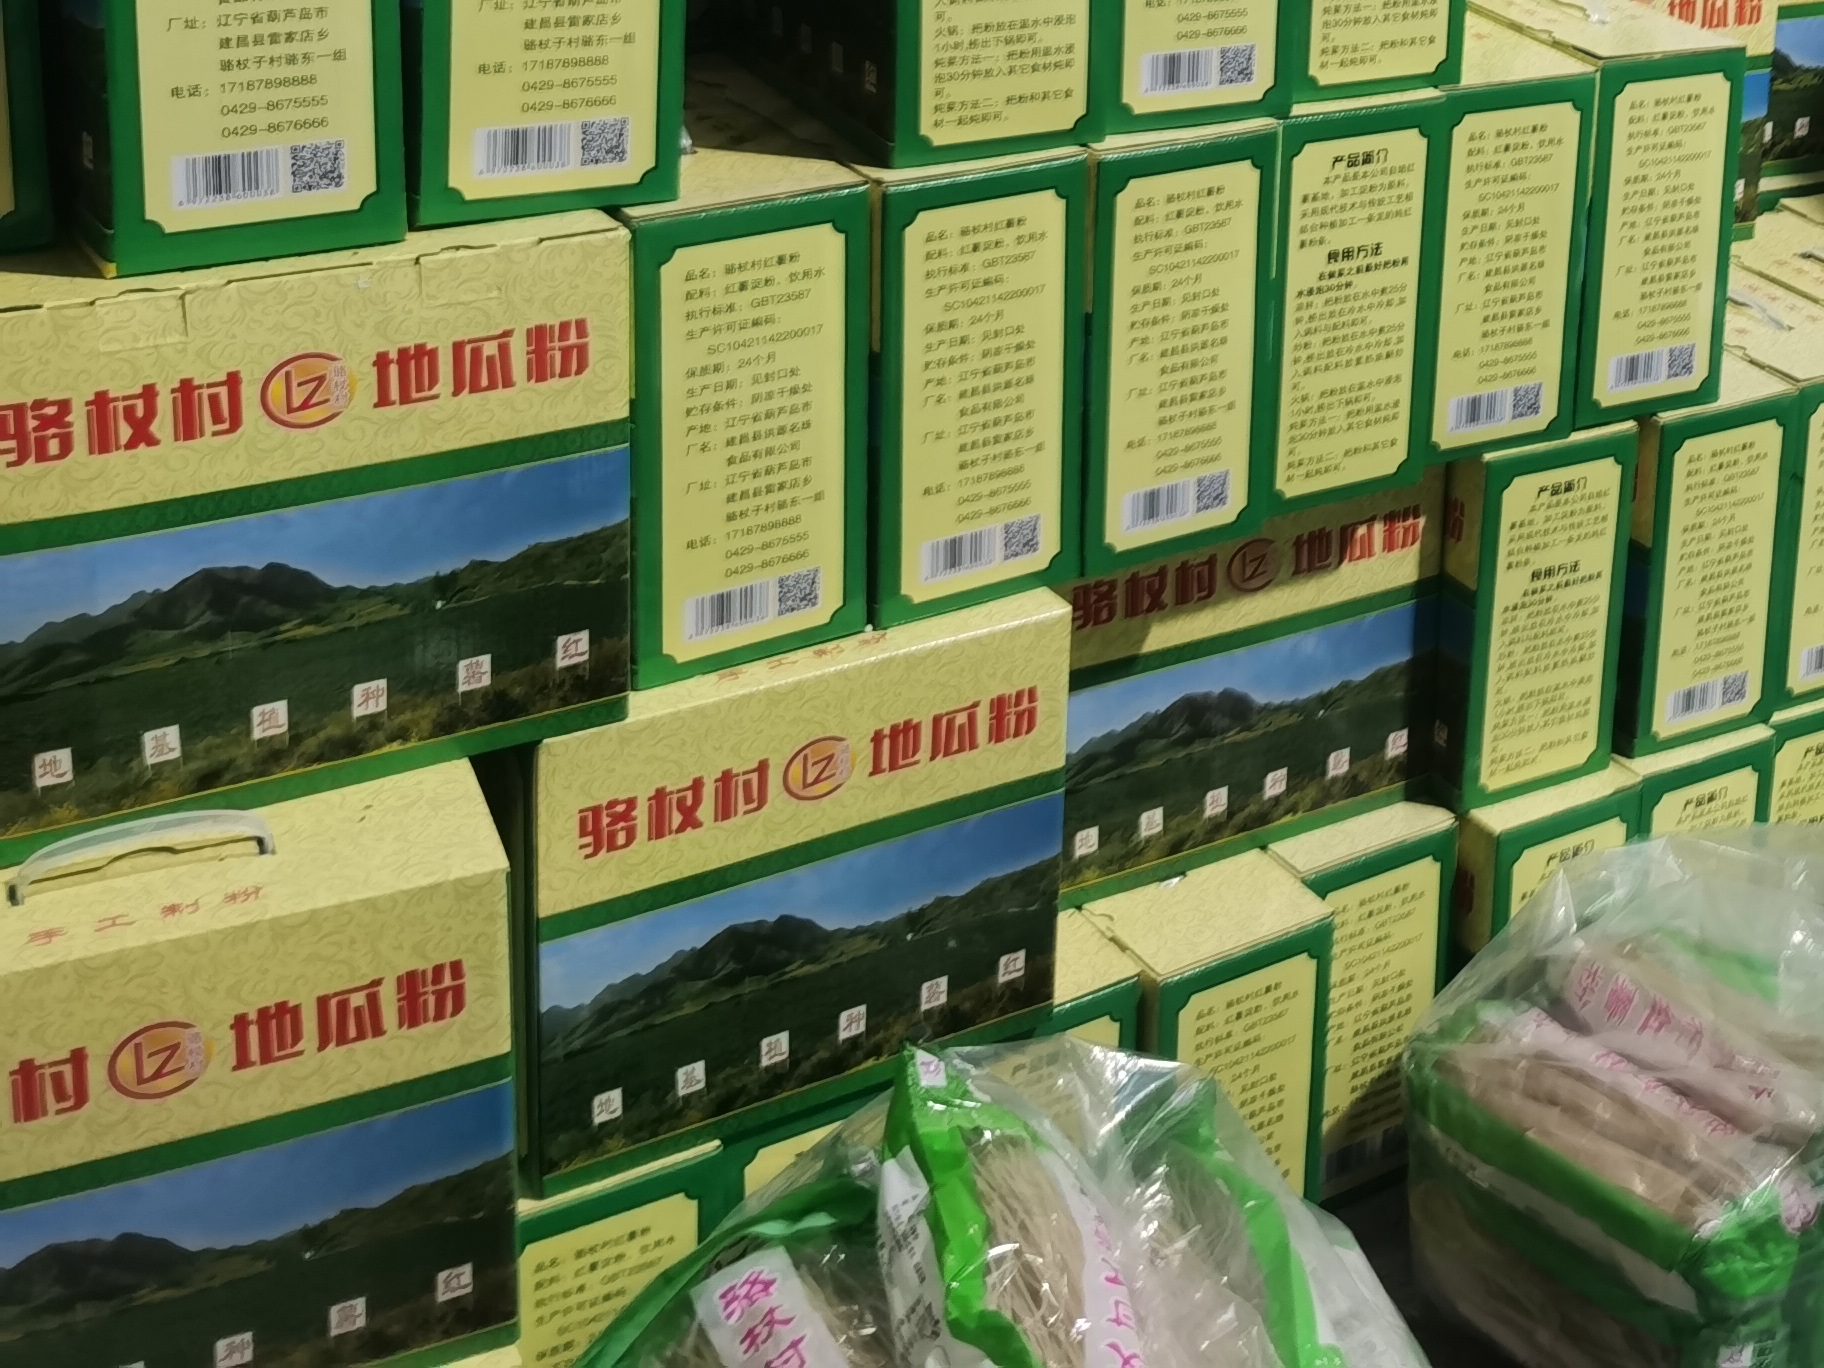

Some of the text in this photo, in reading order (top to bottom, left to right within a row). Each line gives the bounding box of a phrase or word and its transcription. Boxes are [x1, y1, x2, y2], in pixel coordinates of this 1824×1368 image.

[371, 316, 592, 410] 地瓜粉
[1292, 502, 1423, 577] 地瓜粉
[577, 757, 770, 861] 骆杖村
[868, 684, 1039, 778] 地瓜粉
[8, 1046, 90, 1124] 村
[229, 958, 467, 1073] 地瓜粉
